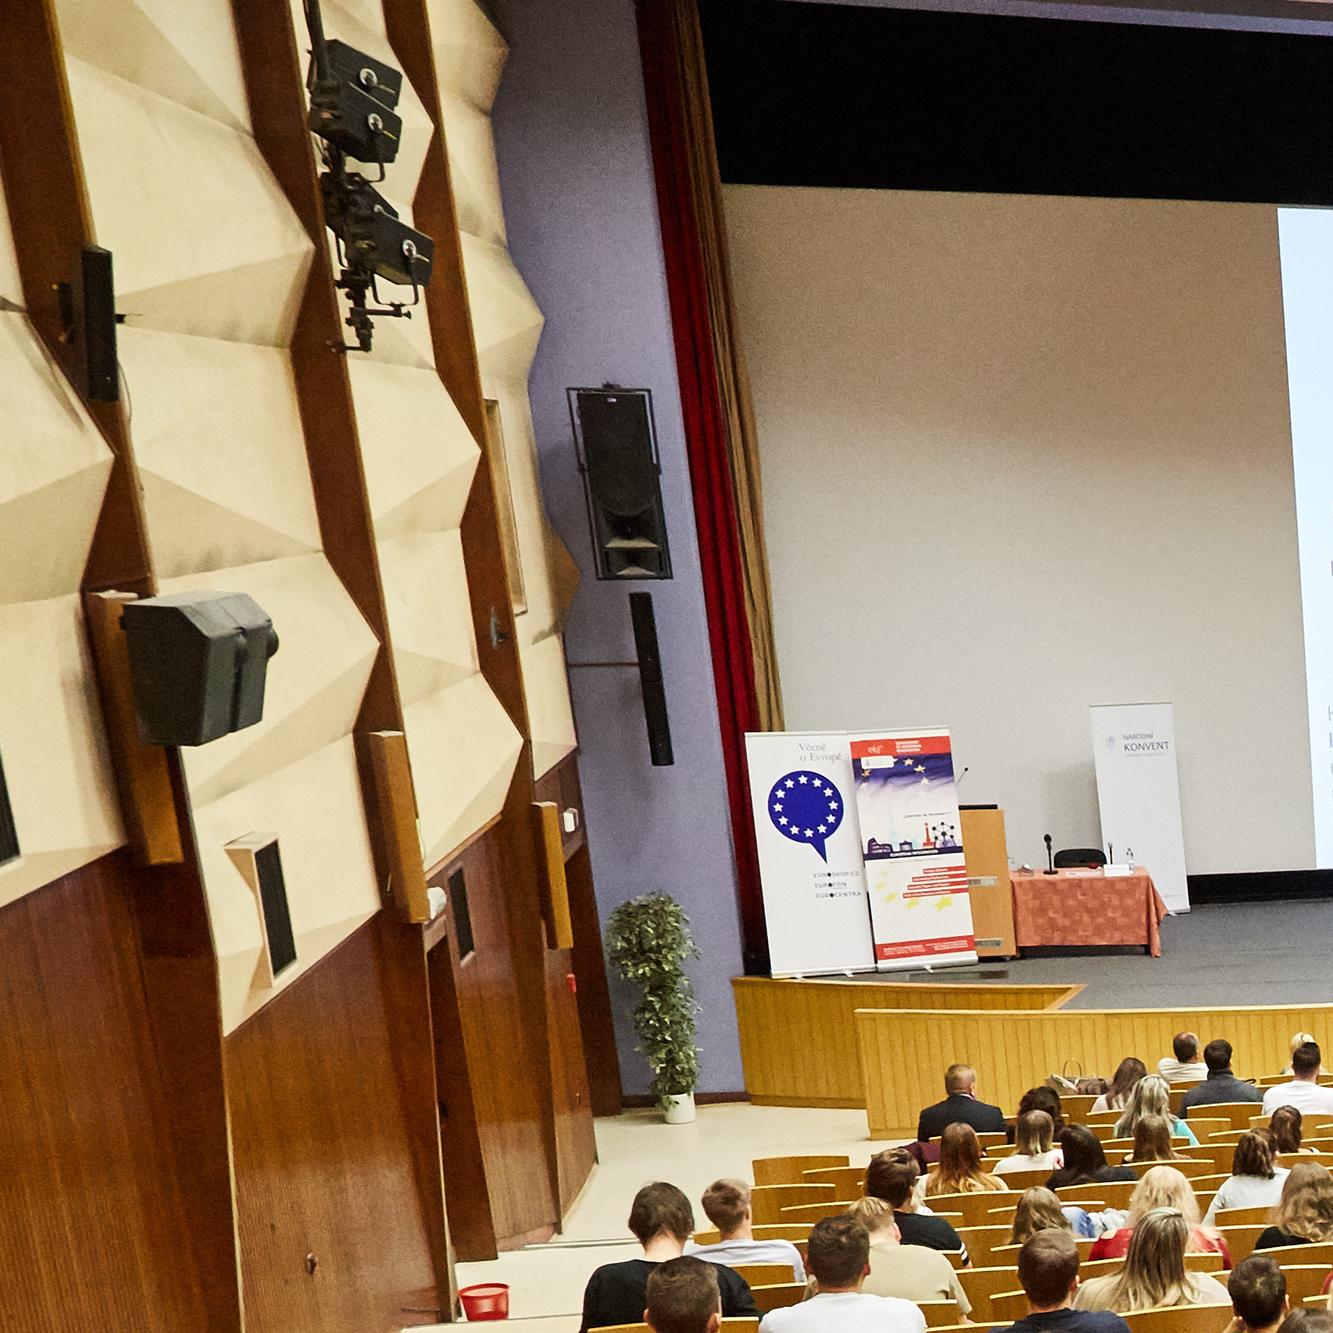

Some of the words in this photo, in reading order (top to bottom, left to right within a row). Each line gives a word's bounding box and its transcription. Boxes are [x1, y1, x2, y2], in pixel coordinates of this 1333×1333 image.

[797, 742, 827, 752] Věcně
[1123, 741, 1169, 752] KONVENT
[809, 753, 842, 763] Evropě
